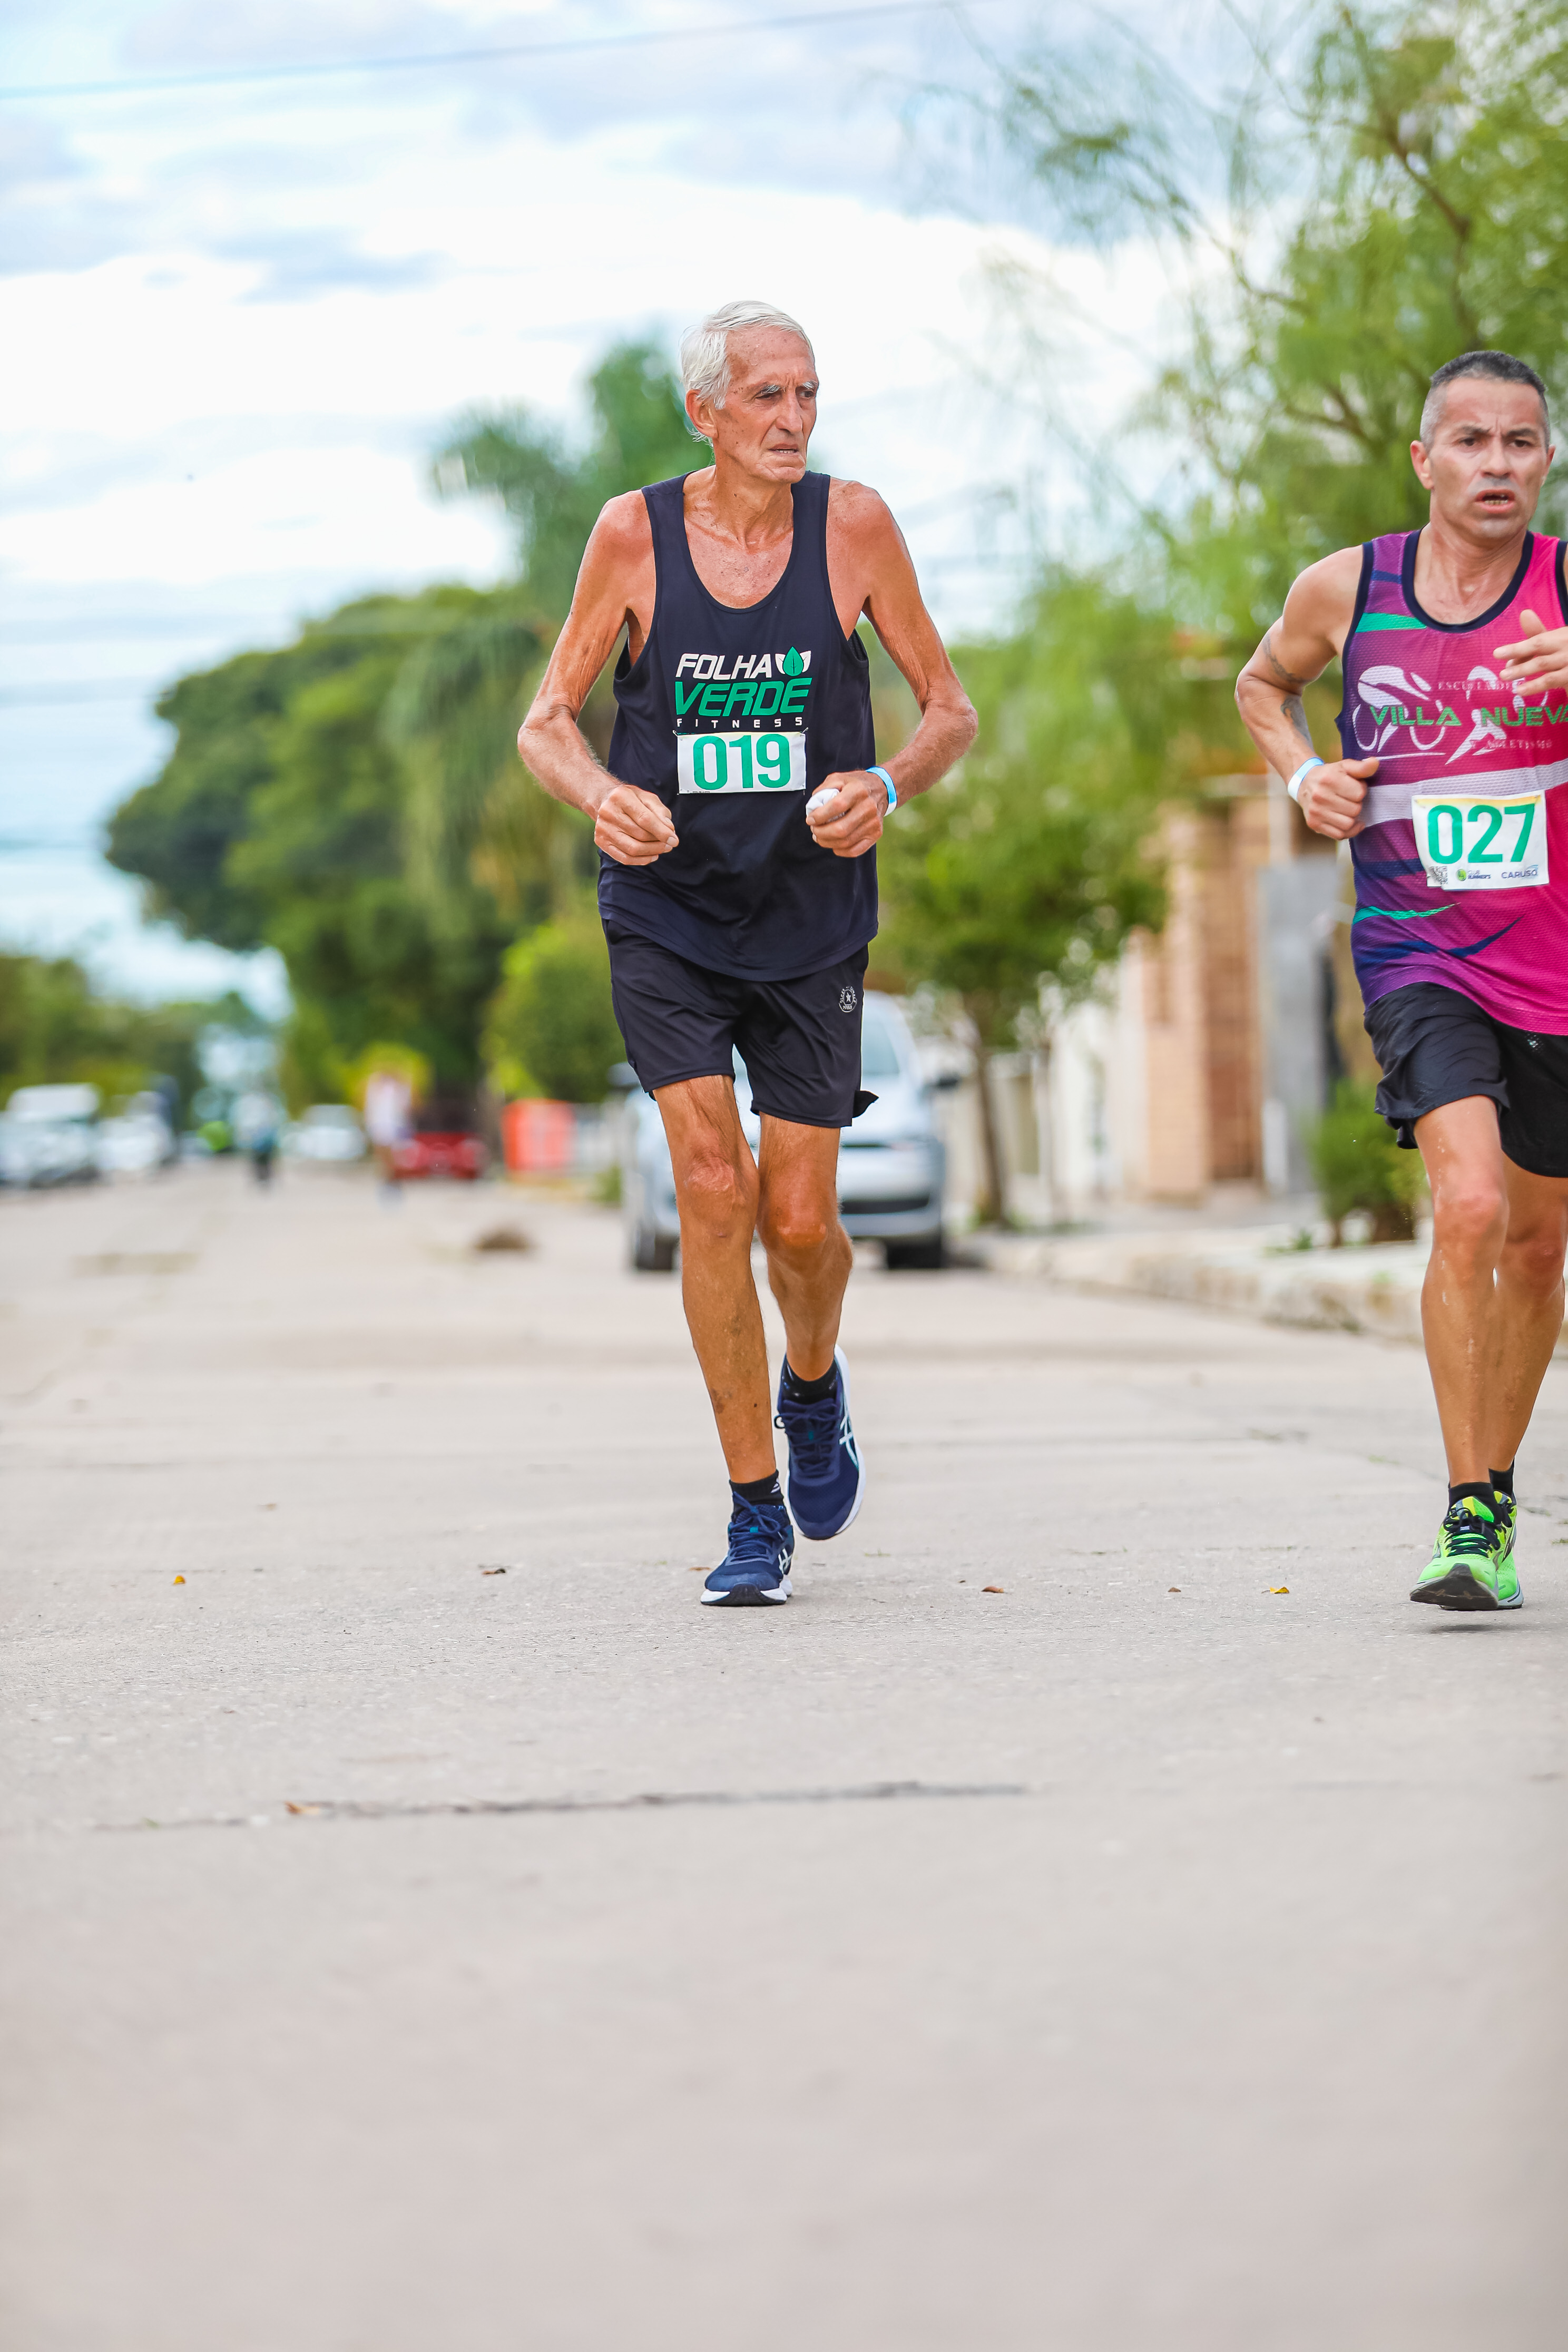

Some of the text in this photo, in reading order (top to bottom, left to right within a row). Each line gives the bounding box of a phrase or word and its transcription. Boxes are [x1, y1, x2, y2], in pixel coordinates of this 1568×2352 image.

[675, 653, 772, 680] FOLHA
[675, 678, 812, 717] VERDE
[677, 717, 802, 729] FITNESS
[1370, 706, 1462, 726] VILLA
[692, 733, 791, 790] 019
[1427, 803, 1535, 864] 027
[1501, 869, 1538, 879] CARUSO
